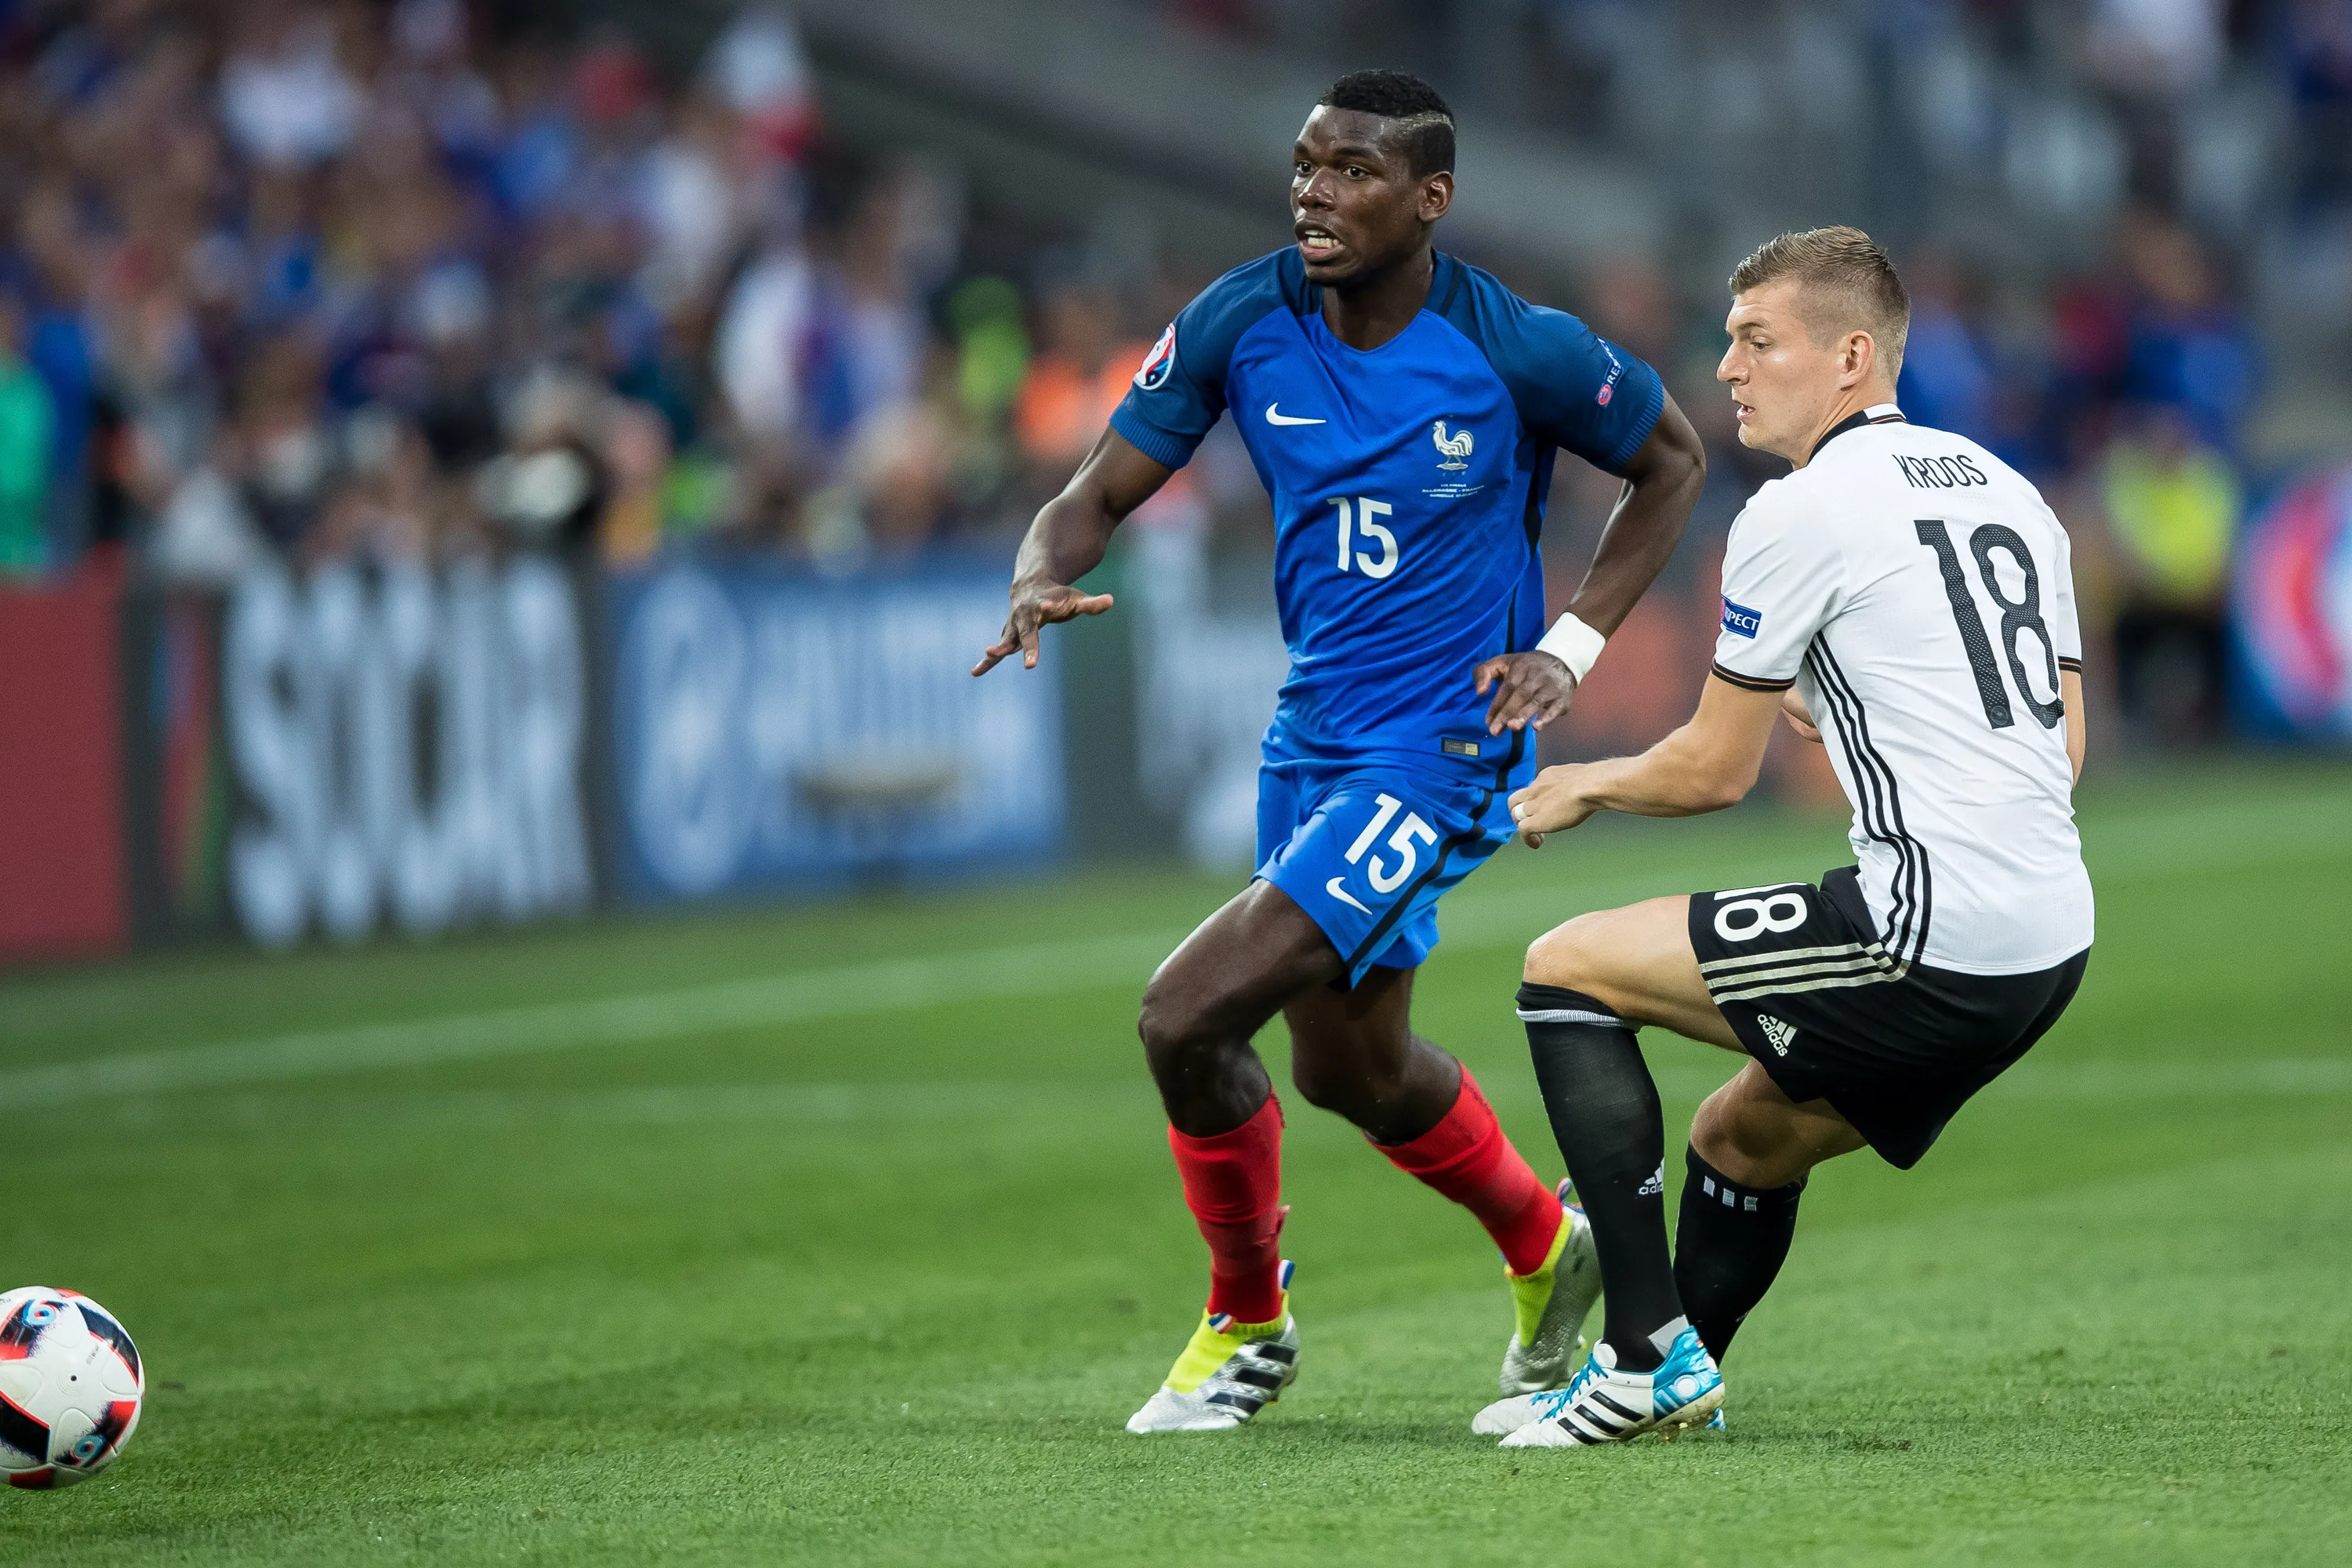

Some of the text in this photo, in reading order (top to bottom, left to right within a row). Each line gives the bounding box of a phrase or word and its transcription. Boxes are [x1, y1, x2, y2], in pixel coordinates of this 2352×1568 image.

[1891, 454, 1987, 488] KROOS
[1327, 496, 1399, 579] 15
[1914, 520, 2064, 729] 18
[1344, 793, 1438, 894] 15
[1757, 1014, 1788, 1056] adidas
